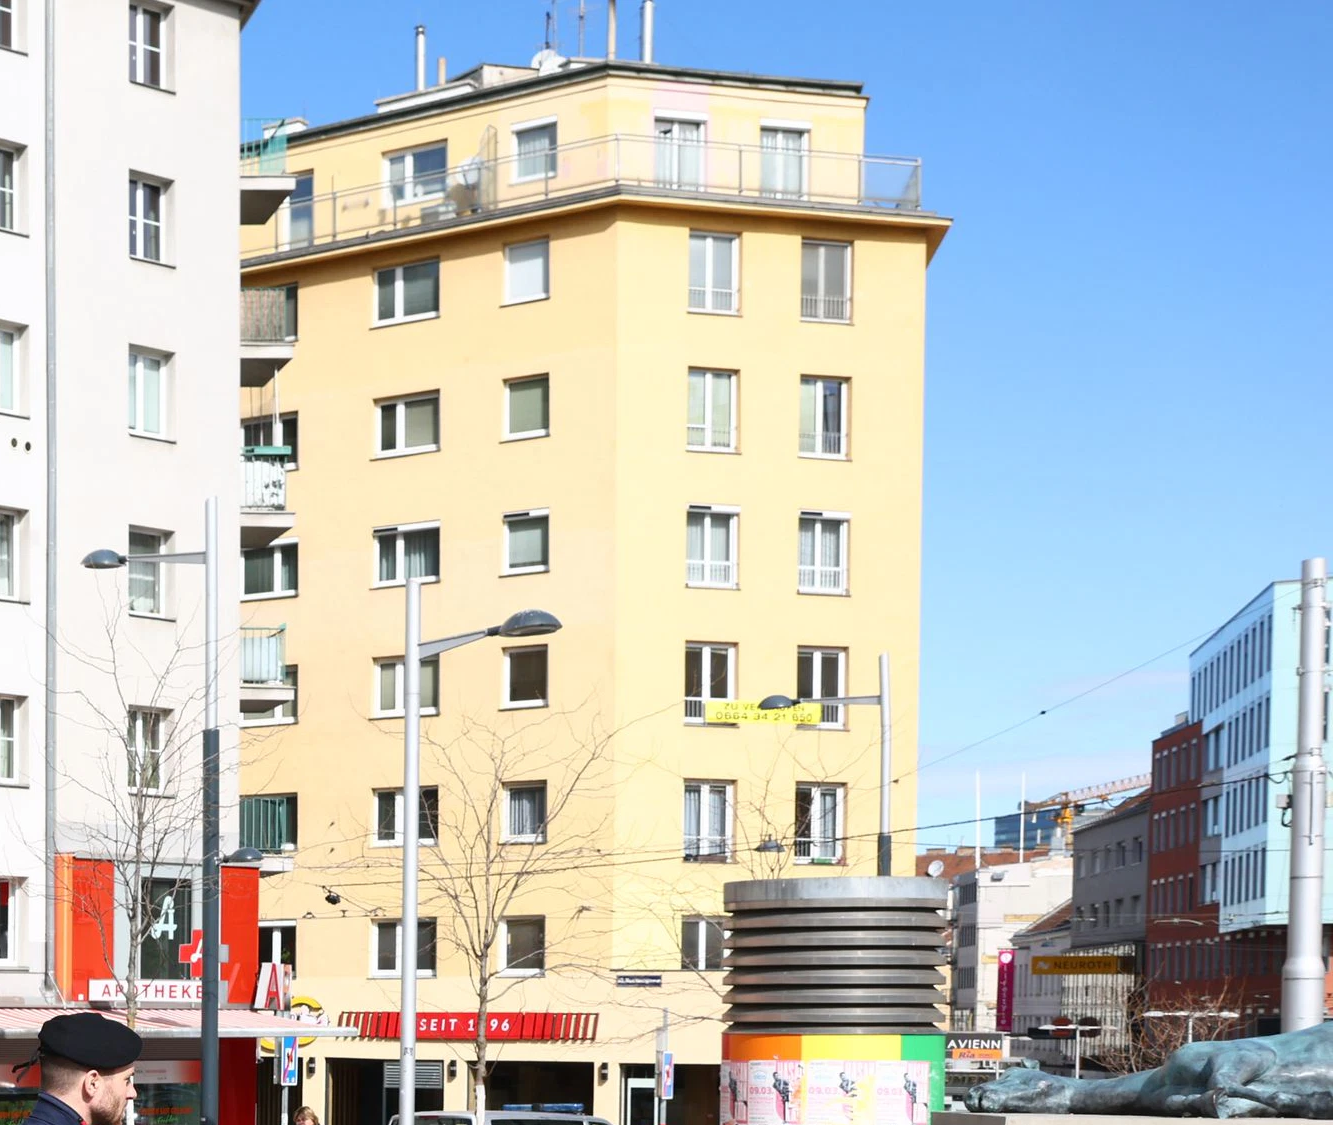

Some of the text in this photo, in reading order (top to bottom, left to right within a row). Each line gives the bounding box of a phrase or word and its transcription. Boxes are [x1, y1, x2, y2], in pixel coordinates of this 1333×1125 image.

[1054, 961, 1112, 969] NEUROTH
[419, 1018, 510, 1031] SEIT 196
